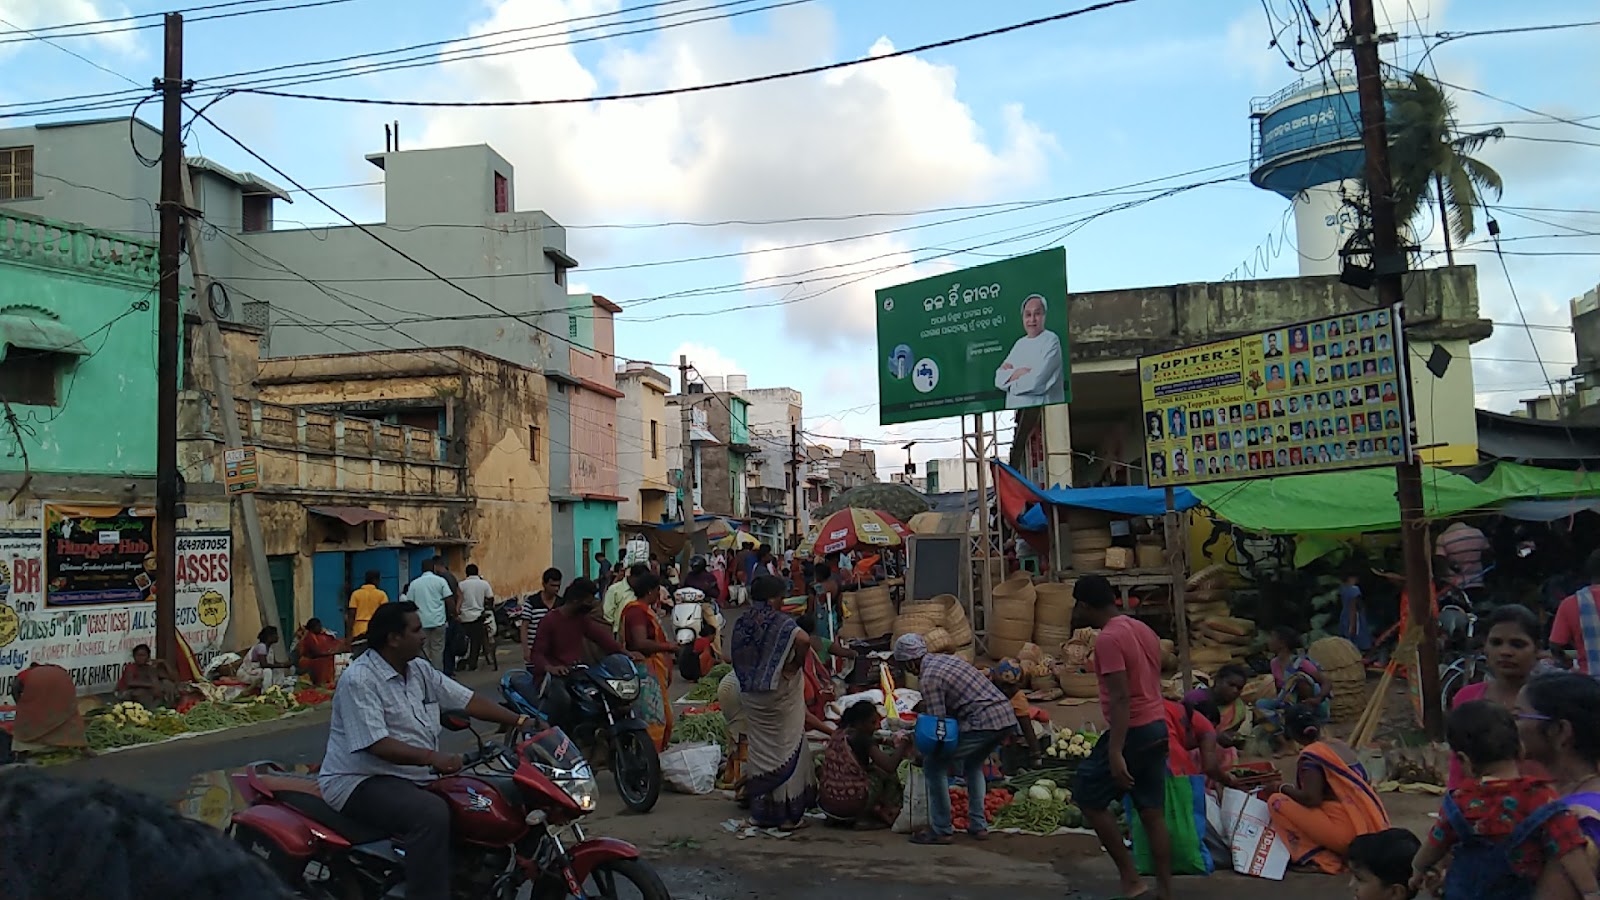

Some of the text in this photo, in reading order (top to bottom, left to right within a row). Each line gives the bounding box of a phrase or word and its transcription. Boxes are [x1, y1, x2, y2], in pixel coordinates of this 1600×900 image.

[962, 283, 1001, 304] ଜୀବନ
[1152, 347, 1240, 373] JUPITER'S
[1153, 359, 1239, 379] EDUCATION
[1188, 400, 1211, 409] Toppers
[1220, 394, 1243, 404] Science
[57, 538, 115, 559] Hunger
[118, 538, 149, 554] Hub
[177, 553, 229, 584] ASSES
[131, 610, 149, 631] ALL
